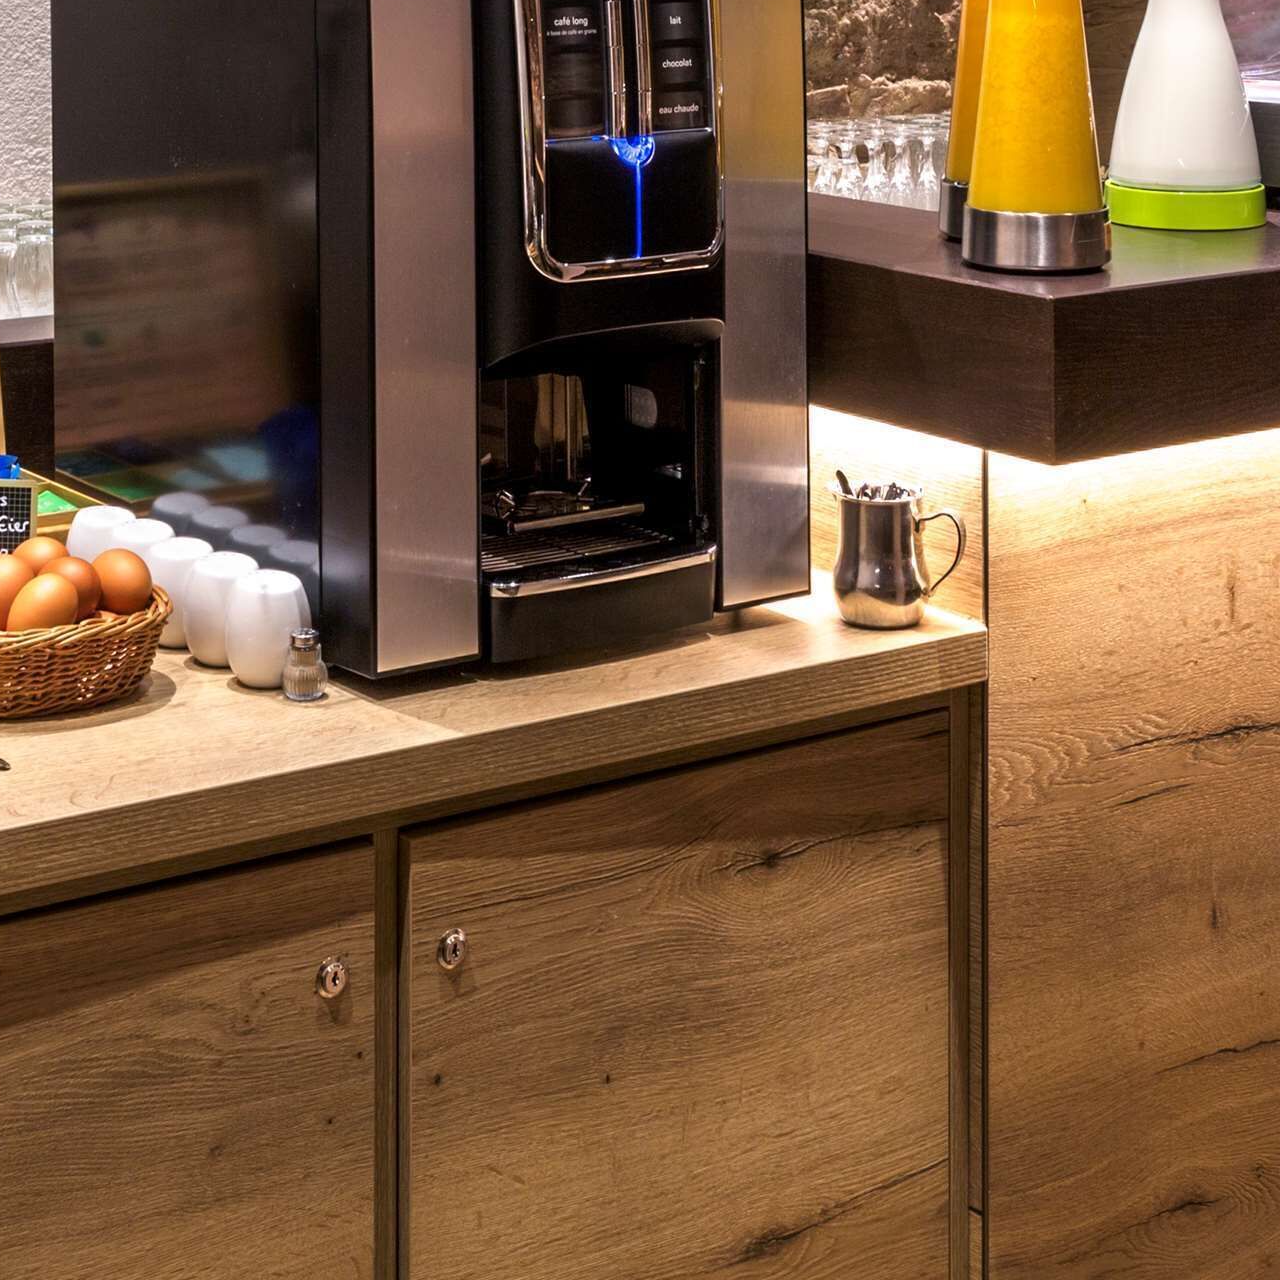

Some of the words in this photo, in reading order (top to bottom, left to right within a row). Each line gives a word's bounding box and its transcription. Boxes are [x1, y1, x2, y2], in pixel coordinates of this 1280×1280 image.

[554, 18, 571, 27] café
[572, 16, 588, 27] long
[669, 16, 682, 25] lait
[662, 58, 692, 68] chocolat
[659, 106, 673, 114] eau
[674, 104, 699, 113] chaude
